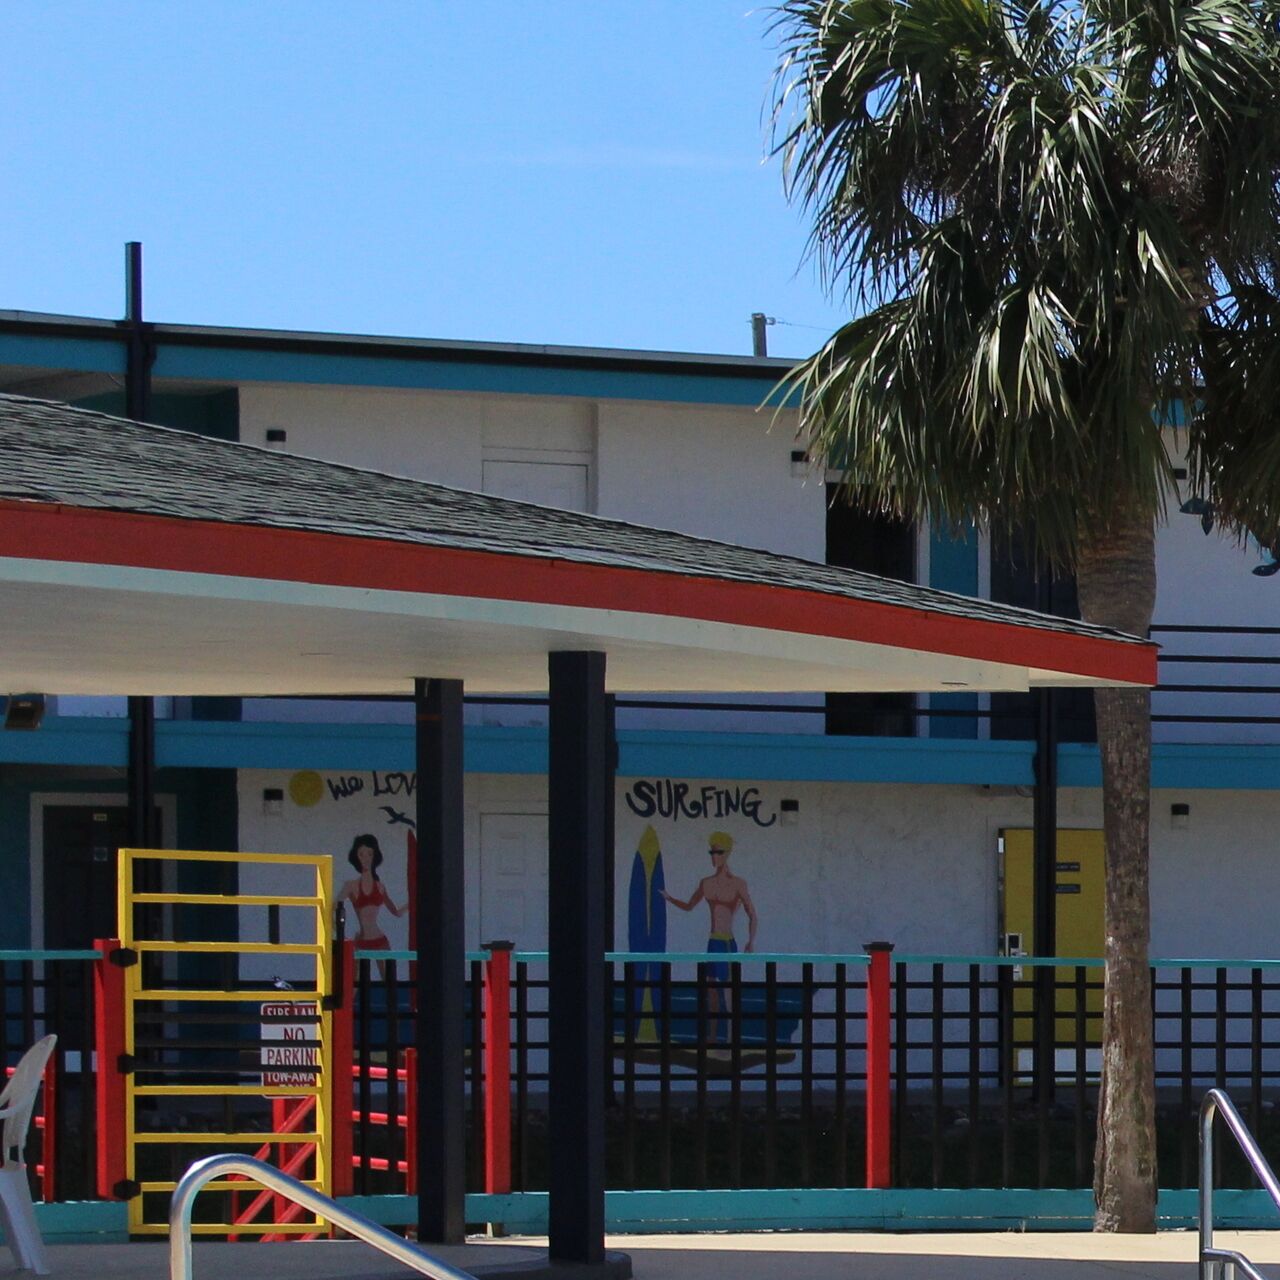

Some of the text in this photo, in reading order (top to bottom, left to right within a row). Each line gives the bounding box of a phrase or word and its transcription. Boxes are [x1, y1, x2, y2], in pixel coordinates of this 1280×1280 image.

[327, 770, 777, 827] We LOV SURFING
[283, 1027, 306, 1040] NO
[267, 1048, 317, 1066] PARKIN
[267, 1072, 316, 1082] TOW-AWA
